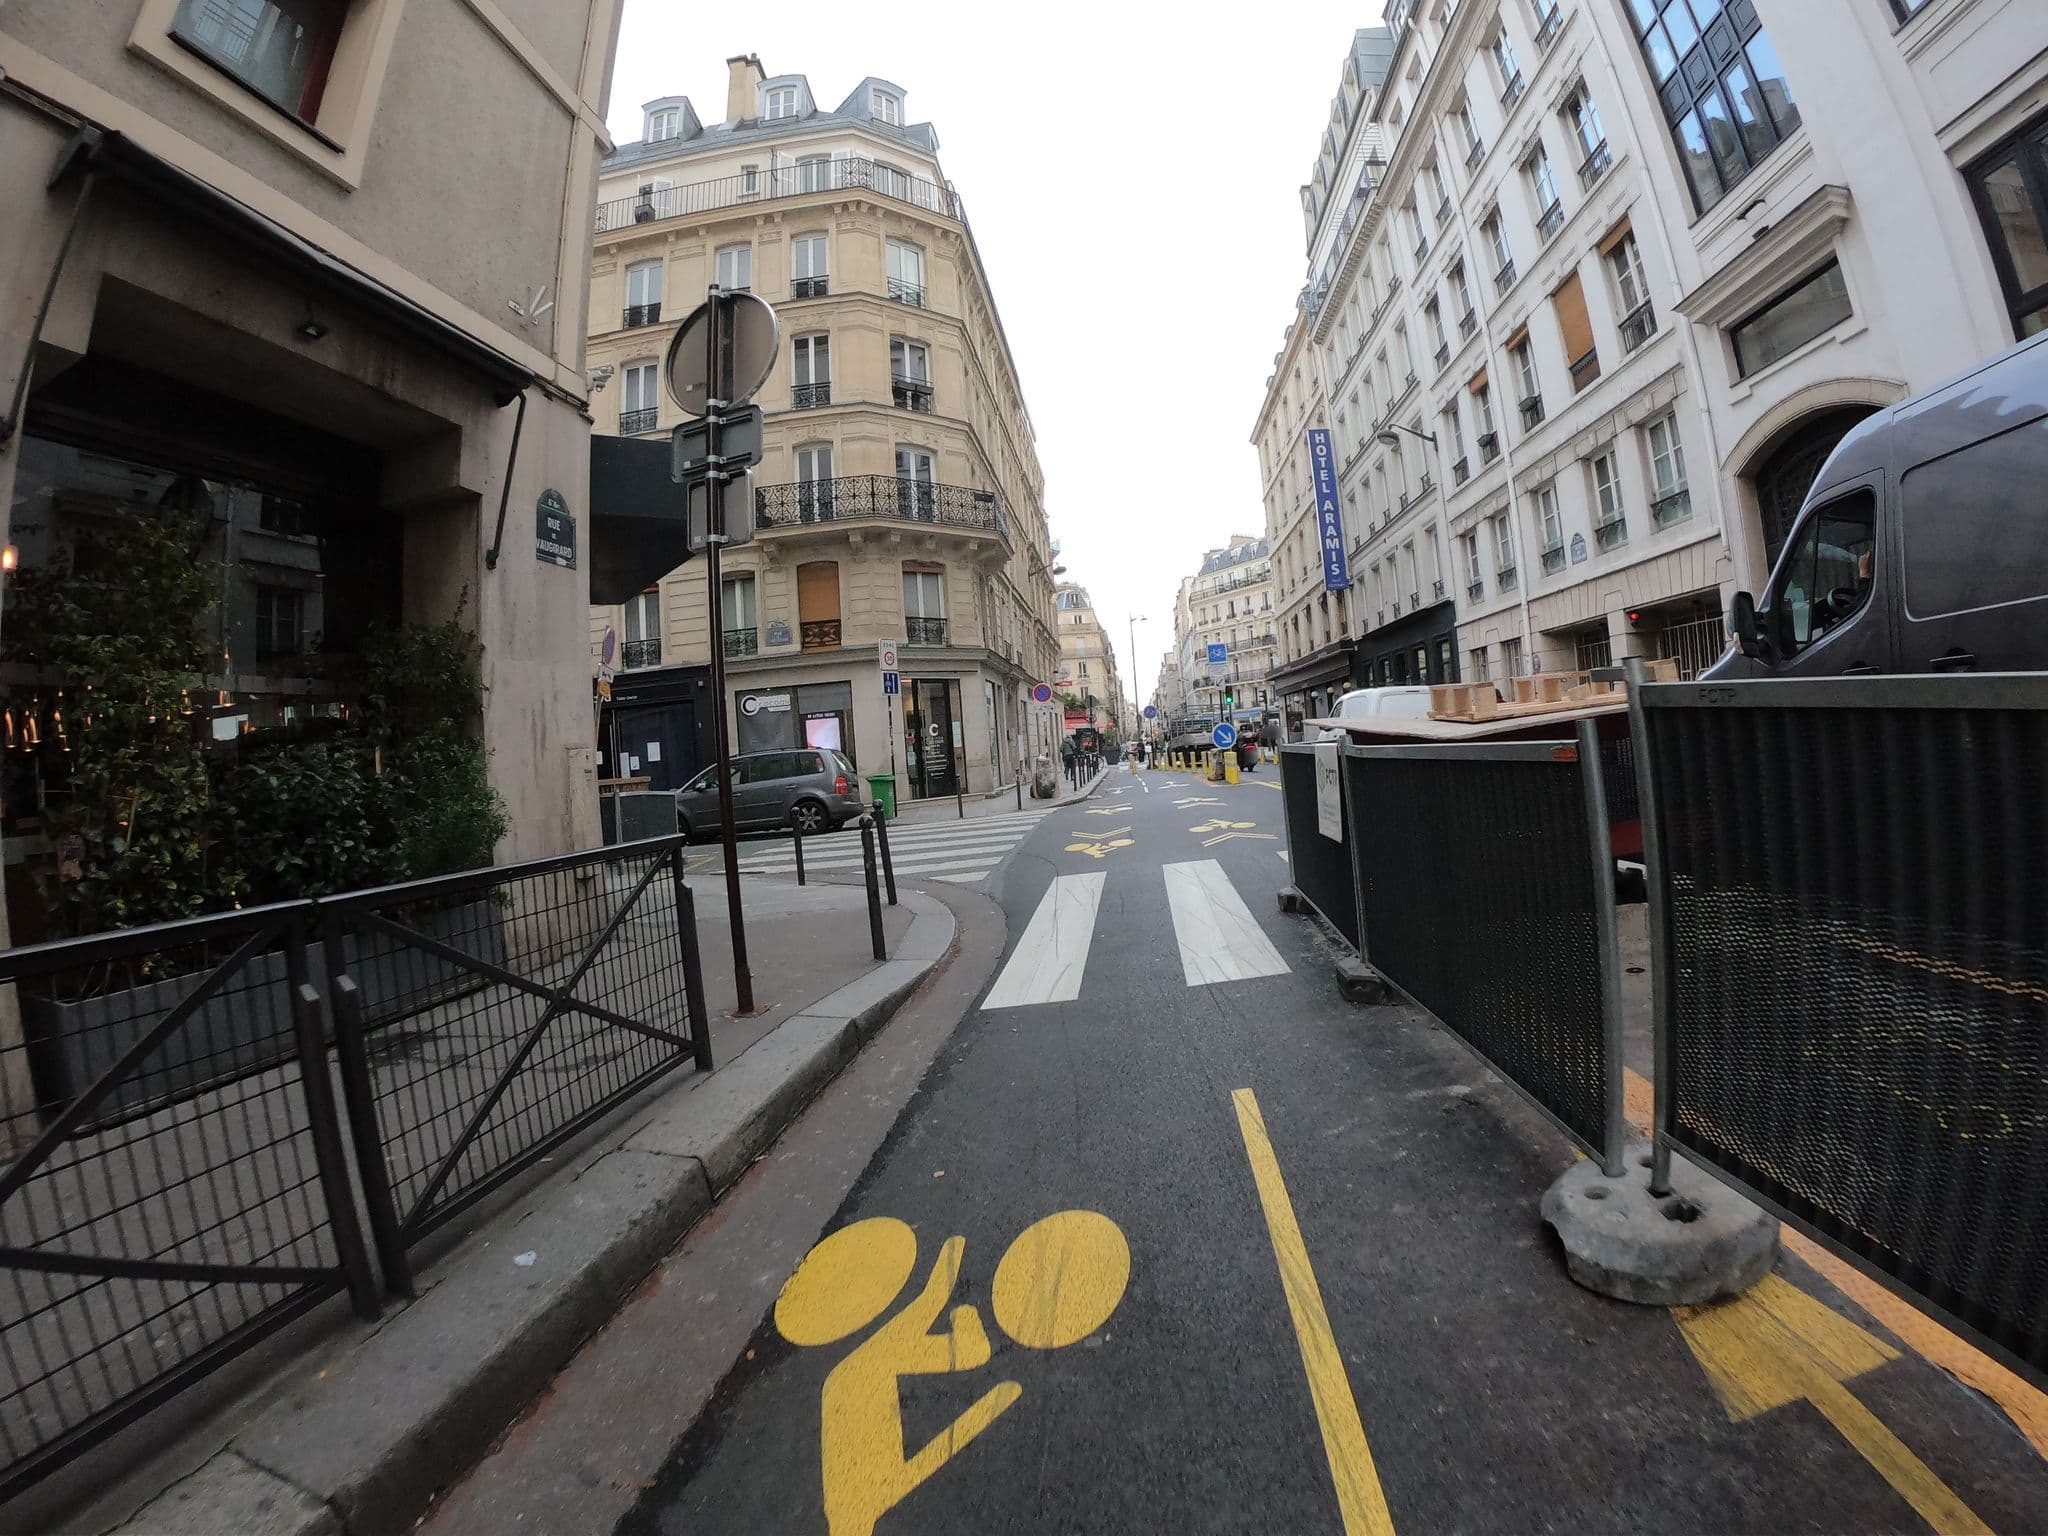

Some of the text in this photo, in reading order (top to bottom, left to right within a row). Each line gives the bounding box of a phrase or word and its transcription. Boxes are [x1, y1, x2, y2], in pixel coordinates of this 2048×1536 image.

[1314, 432, 1331, 494] HOTEL
[1323, 500, 1340, 576] ARAMIS
[547, 516, 561, 531] RUE
[536, 538, 573, 559] VAUGIRARD
